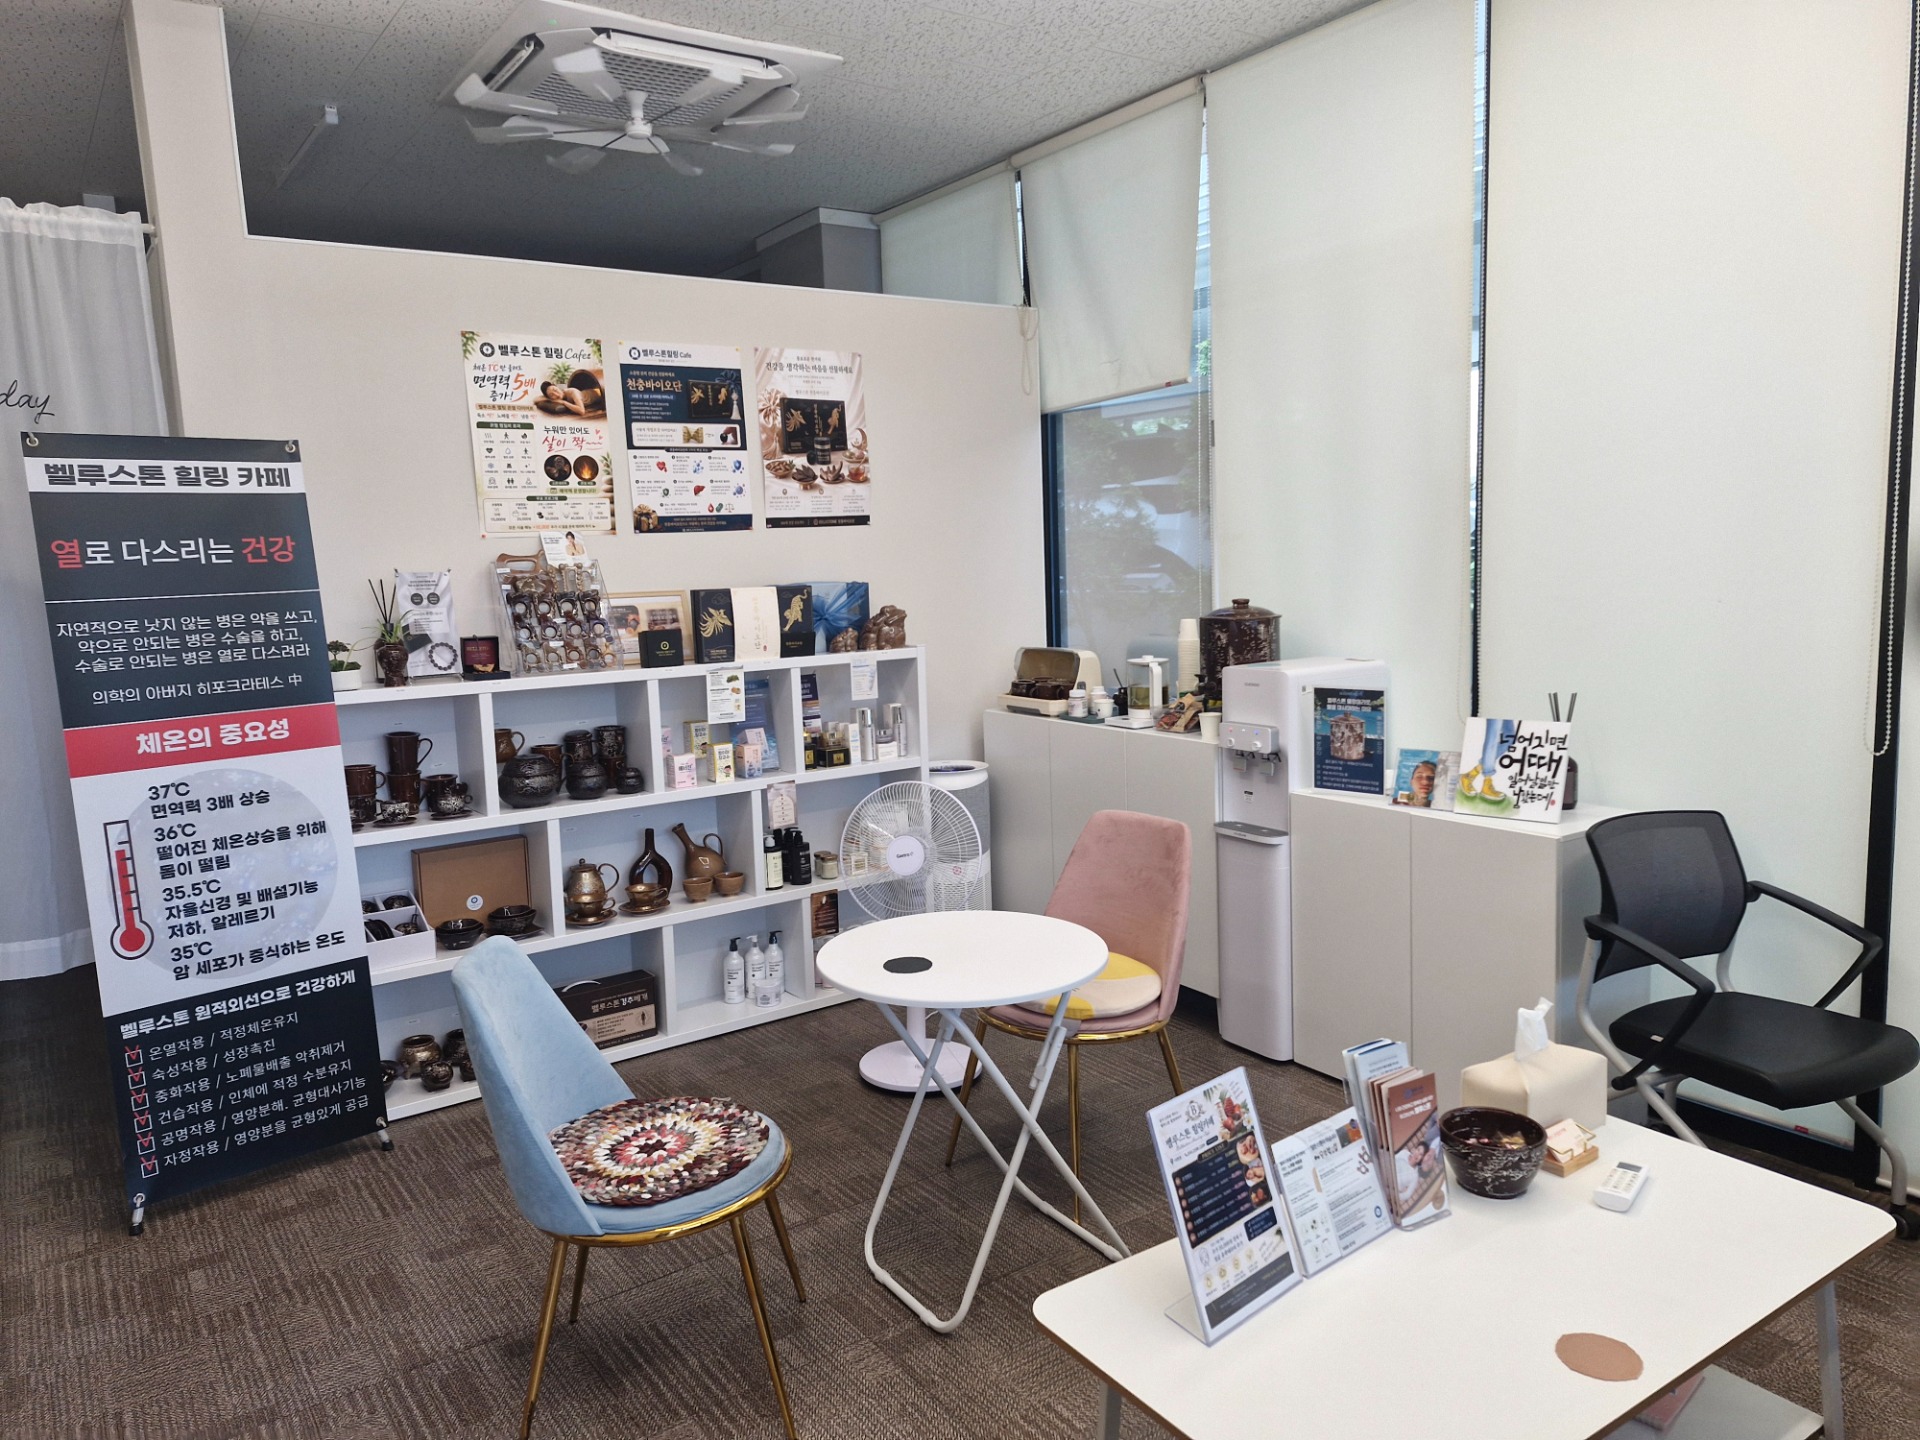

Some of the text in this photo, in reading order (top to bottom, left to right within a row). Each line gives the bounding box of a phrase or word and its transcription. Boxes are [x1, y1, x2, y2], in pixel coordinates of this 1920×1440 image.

[498, 344, 541, 358] 벨루스톤
[544, 346, 564, 359] 힐링
[679, 351, 692, 359] Cafe
[765, 362, 784, 371] 건강을
[786, 363, 811, 373] 생각하는
[473, 373, 536, 390] 면역력 5배
[489, 390, 514, 402] 증가!
[544, 426, 590, 435] 누워만 있어도
[44, 463, 292, 488] 벨루스톤 힐링 카페
[50, 535, 296, 569] 열로 다스리는 건강
[56, 610, 318, 637] 자연적으로 낫지 않는 병은 약을 쓰고,
[75, 643, 311, 673] 수술로 안되는 병은 열로 다스려라
[78, 638, 129, 655] 약으로
[132, 635, 181, 651] 안되는
[185, 632, 216, 648] 병은
[221, 629, 265, 645] 수술을
[92, 673, 303, 705] 의학의 아버지 히포크라테스 中
[136, 718, 290, 755] 체온의 중요성
[1500, 720, 1568, 753] 넘어지면
[1499, 746, 1563, 779] 어때
[150, 789, 271, 820] 면역력 3배 상승
[156, 820, 327, 861] 떨어진 체온상승을 위해
[159, 854, 231, 880] 몸이 떨림
[165, 881, 319, 922] 자율신경 및 배설기능
[167, 906, 276, 940] 저하, 알레르기
[172, 929, 346, 981] 암 세포가 증식하는 온도
[120, 969, 356, 1040] 벨루스톤 원적외선으로 건강하게
[591, 999, 620, 1013] 벨루스톤
[149, 1011, 299, 1061] 온열작용 / 적정체온유지
[152, 1038, 276, 1080] 숙성작용 / 성장촉진
[154, 1040, 346, 1103] 중화작용 / 노폐물배출 악취제거
[158, 1059, 352, 1125] 건습작용 / 인체에 적정 수분유지
[161, 1119, 217, 1146] 공명작용
[222, 1116, 227, 1131] /
[292, 1076, 367, 1107] 균형대사기능
[164, 1094, 369, 1167] 자정작용 / 영양분을 균형있게 공급
[1165, 1128, 1191, 1149] 벨루스톤
[1191, 1114, 1215, 1135] 힐링카페
